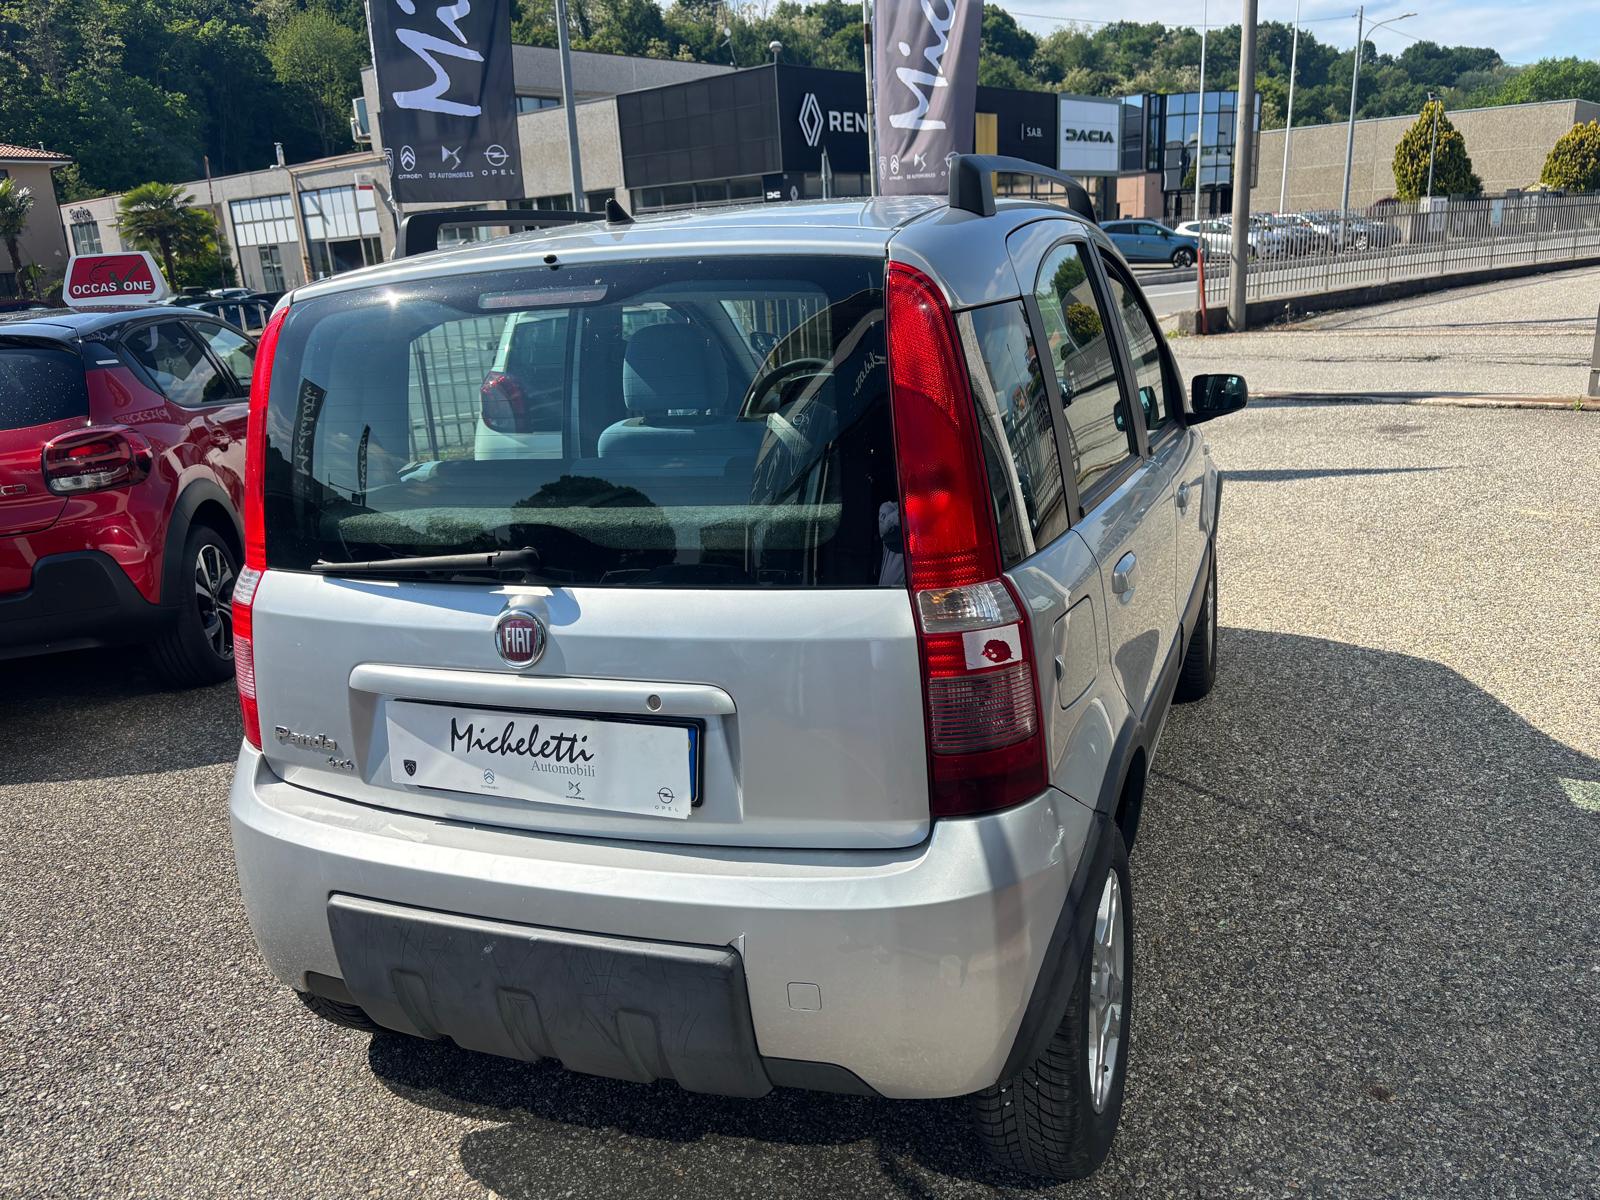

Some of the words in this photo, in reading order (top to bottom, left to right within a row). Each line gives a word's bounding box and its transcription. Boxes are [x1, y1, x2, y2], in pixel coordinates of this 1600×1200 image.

[828, 111, 869, 133] REN
[1065, 128, 1114, 143] DACIA
[437, 171, 474, 179] AUTOMOBILES
[505, 627, 532, 653] FIAT
[274, 725, 337, 751] Panda
[451, 717, 595, 764] Micheletti
[531, 760, 596, 777] Automobili
